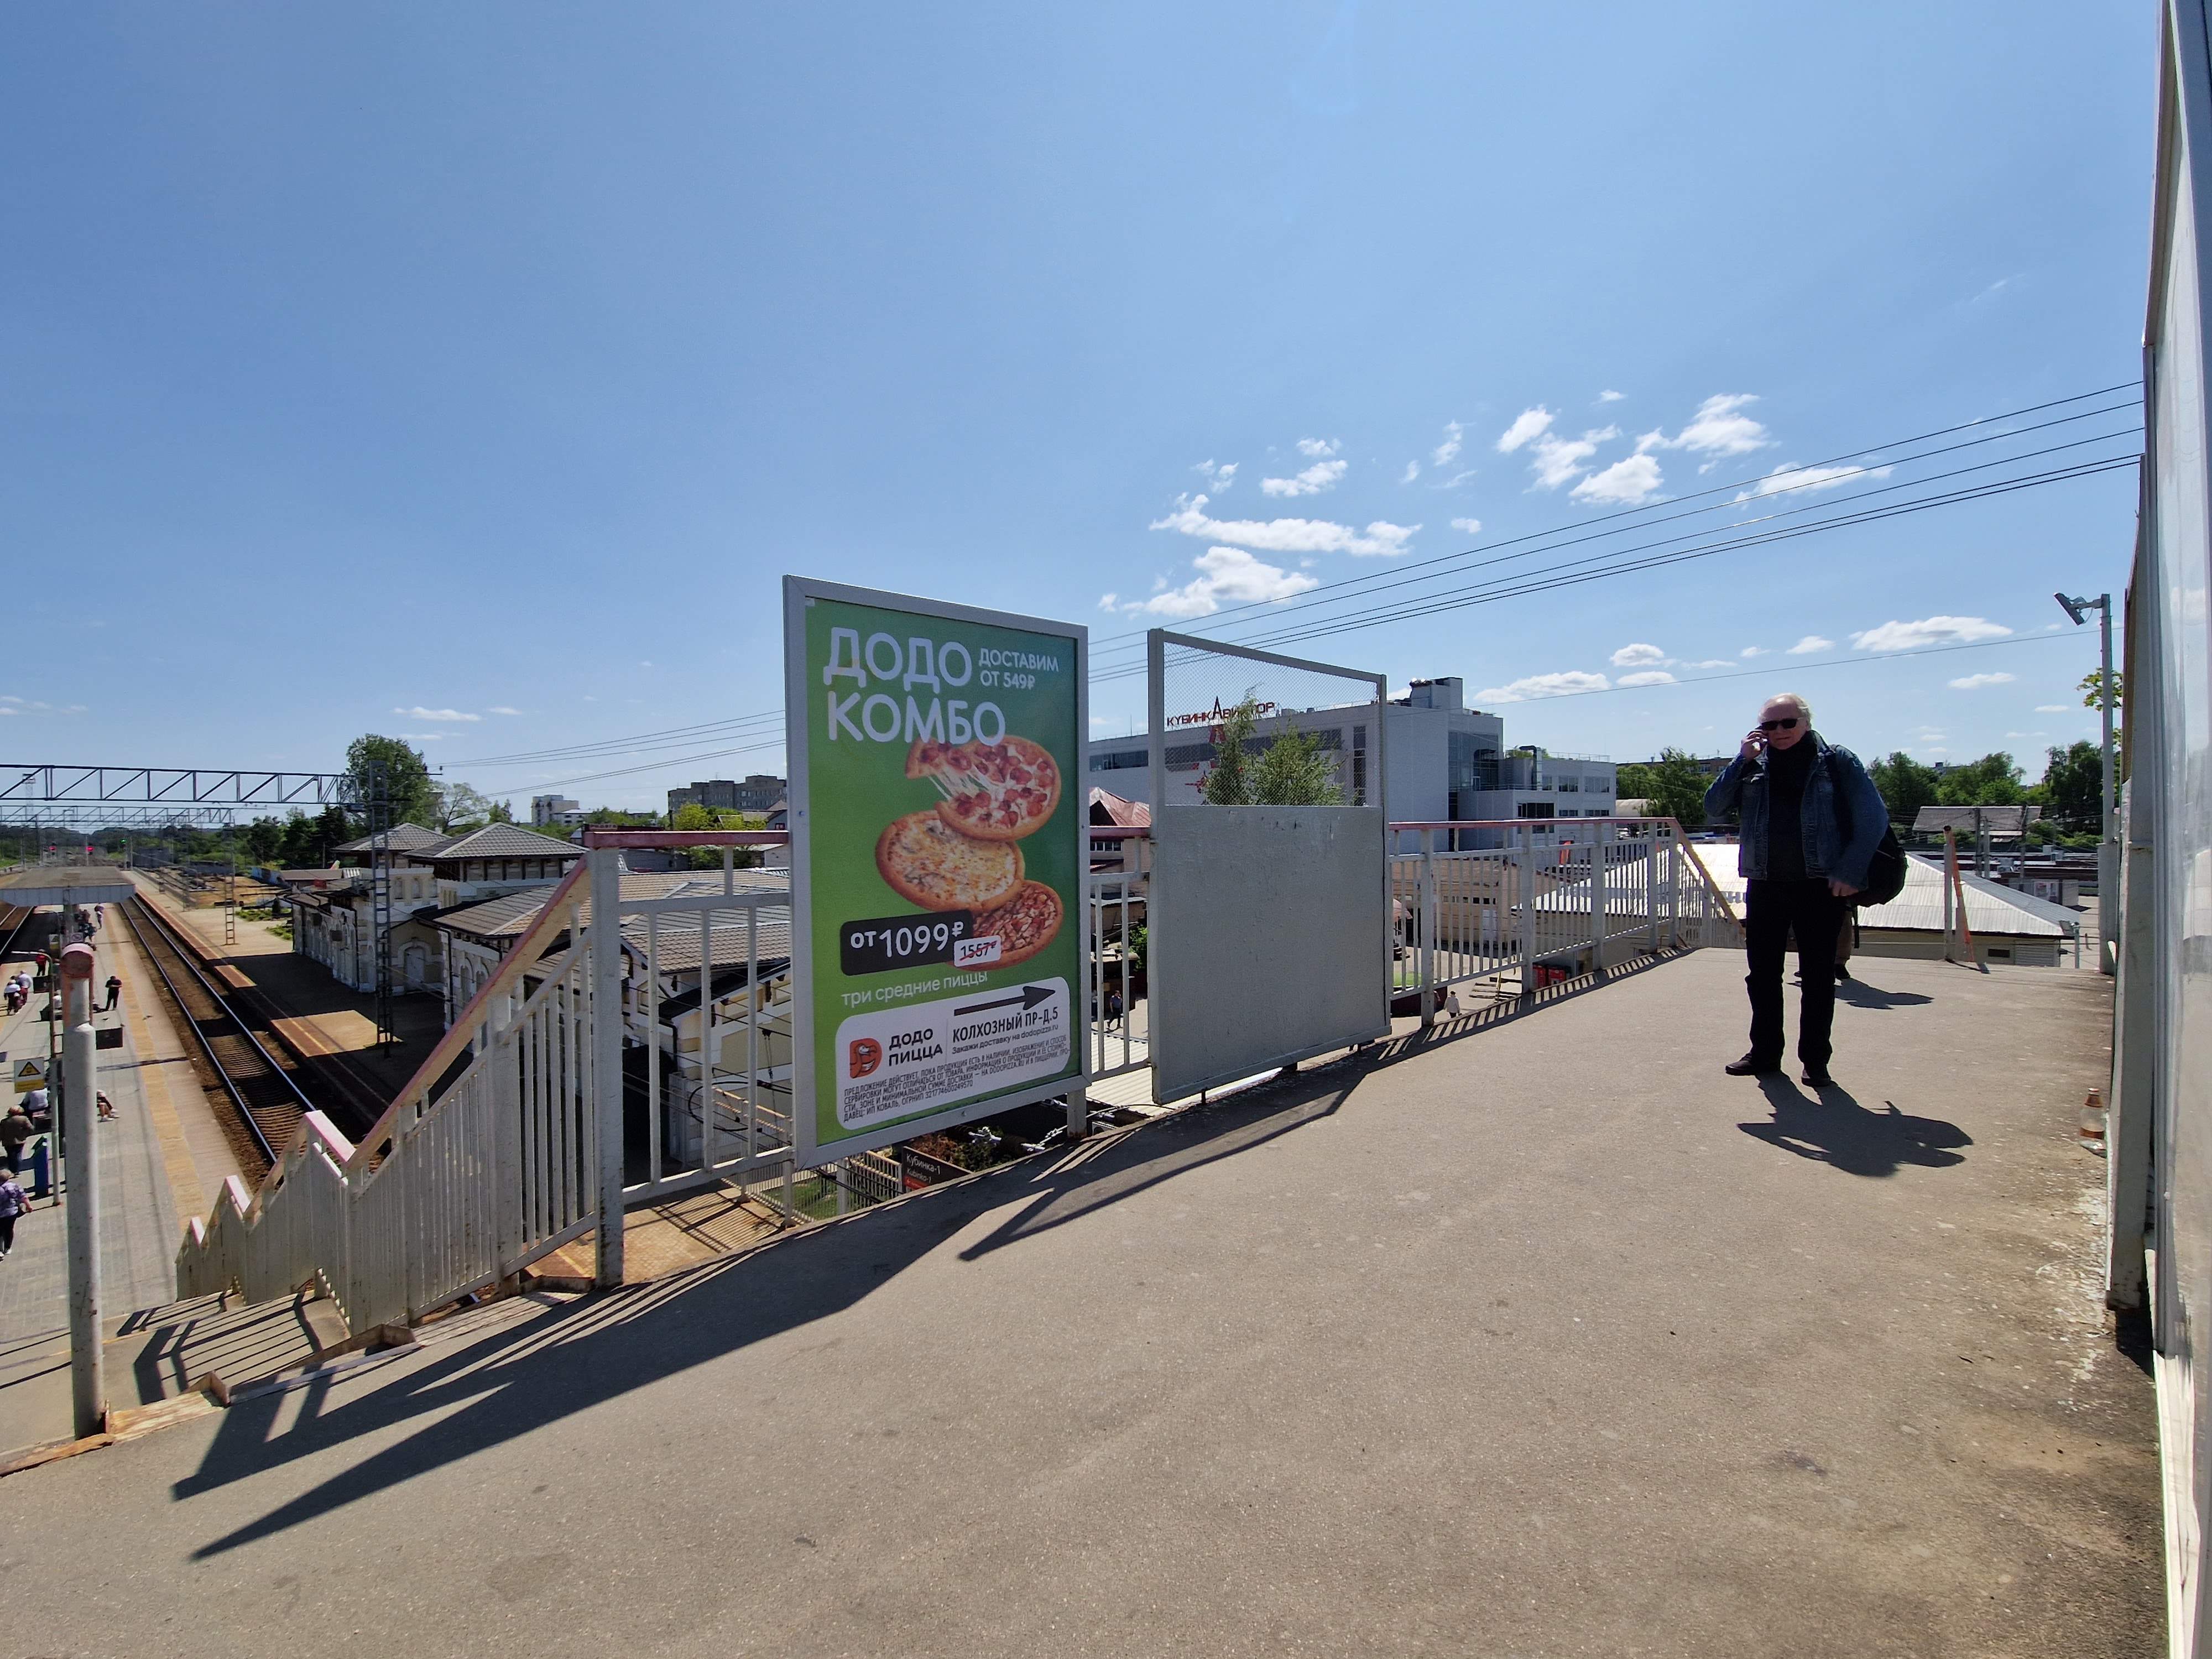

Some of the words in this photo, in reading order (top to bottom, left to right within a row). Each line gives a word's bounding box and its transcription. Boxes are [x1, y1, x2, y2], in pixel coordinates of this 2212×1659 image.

[823, 627, 972, 693] ДОДО
[979, 648, 1059, 672] ДОСТАВИМ
[980, 670, 1000, 686] ОТ
[829, 691, 1005, 746] КОМБО
[841, 990, 872, 1008] три
[875, 979, 940, 1002] средние
[943, 971, 988, 989] пиццы
[889, 1029, 933, 1051] ДОДО
[952, 1044, 978, 1054] Закажи
[979, 1036, 1011, 1049] доставку
[1021, 1024, 1058, 1037] dodopizza.ru
[953, 1013, 1022, 1042] КОЛХОЗНЫЙ
[889, 1044, 943, 1067] ПИЦЦА
[844, 1079, 887, 1096] ПРЕДЛОЖЕНИЕ
[921, 1067, 935, 1077] ПОКА
[937, 1059, 967, 1072] ПРОДУКЦИЯ
[969, 1056, 980, 1065] ЕСТЬ
[844, 1089, 881, 1104] СЕРВИРОВКИ
[883, 1083, 901, 1094] МОГУТ
[903, 1074, 935, 1089] ОТЛИЧАТЬСЯ
[859, 1098, 874, 1109] ЗОНЕ
[882, 1084, 926, 1102] МИНИМАЛЬНОЙ
[928, 1079, 946, 1090] СУММЕ
[947, 1073, 973, 1086] ДОСТАВКИ
[867, 1106, 875, 1115] ИП
[902, 1093, 924, 1105] ОГРНИП
[907, 1154, 940, 1175] Кубинка-1
